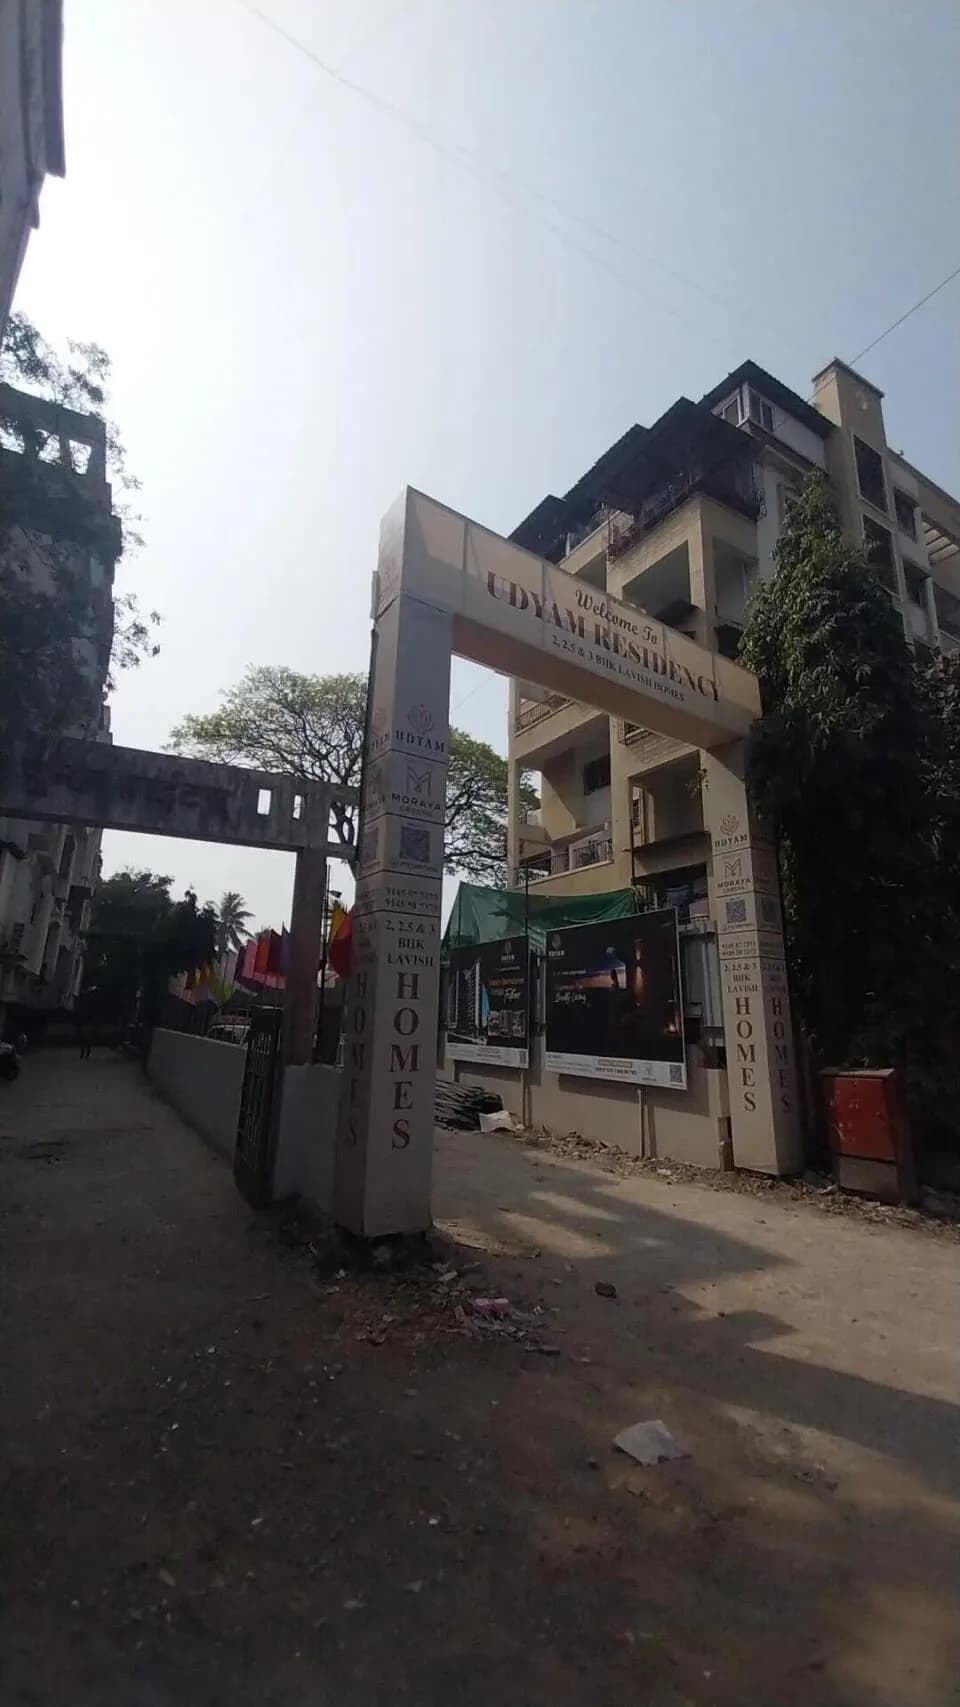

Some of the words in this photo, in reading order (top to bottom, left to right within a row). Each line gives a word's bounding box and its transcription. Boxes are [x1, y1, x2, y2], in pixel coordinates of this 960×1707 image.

[576, 589, 638, 635] Welcome
[642, 625, 658, 645] To
[487, 571, 584, 640] UDYAM
[595, 623, 719, 702] RESIDENCY
[619, 664, 652, 687] LAVISH
[395, 730, 446, 753] UDYAM
[391, 793, 442, 811] MORAYA
[714, 833, 748, 849] UDYAM
[717, 878, 752, 888] MORAYA
[398, 937, 425, 951] BHK
[384, 952, 434, 967] LAVISH
[733, 974, 752, 983] BHK
[727, 984, 760, 994] LAVISH
[390, 972, 420, 1150] HOMES
[735, 997, 756, 1112] HOMES
